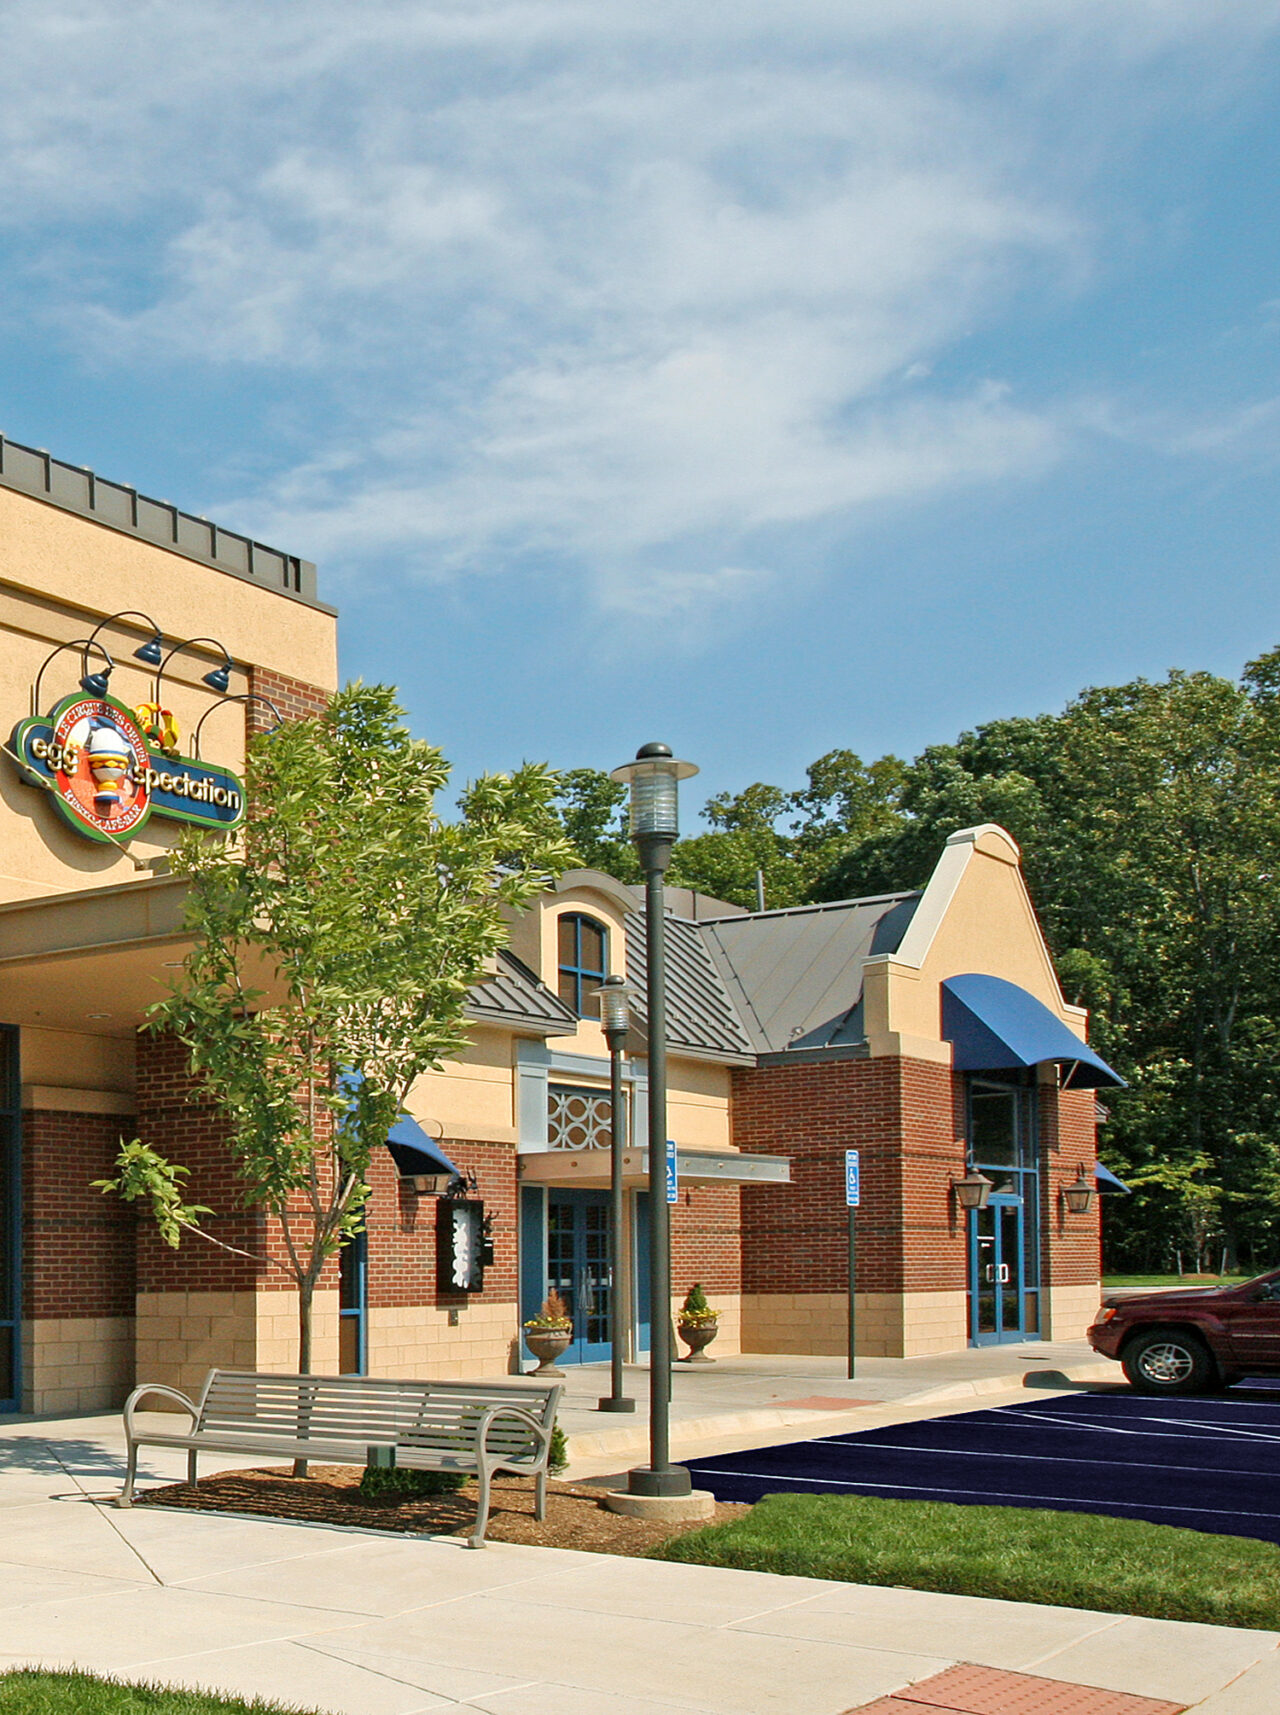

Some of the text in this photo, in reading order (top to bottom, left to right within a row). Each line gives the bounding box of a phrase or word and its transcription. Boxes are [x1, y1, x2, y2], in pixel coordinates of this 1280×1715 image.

[57, 720, 70, 738] LE
[66, 702, 102, 723] CIRQUE
[32, 737, 240, 810] egg spectation
